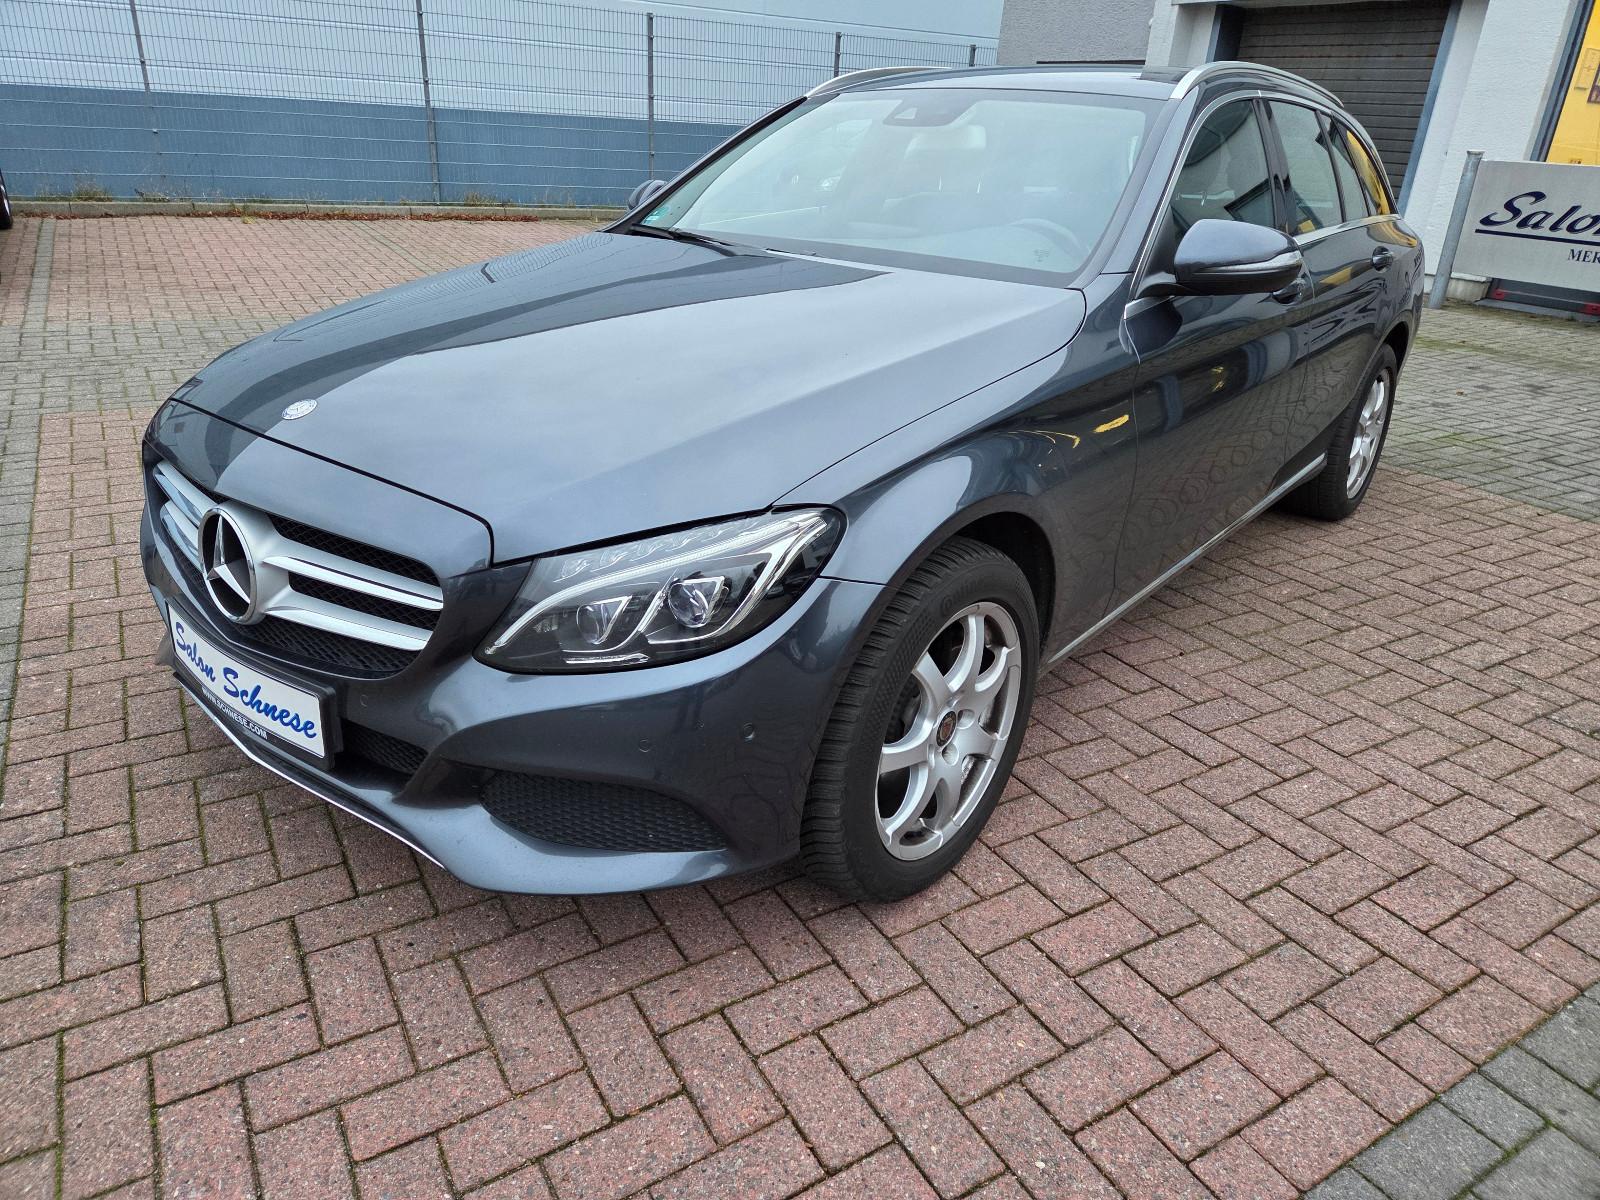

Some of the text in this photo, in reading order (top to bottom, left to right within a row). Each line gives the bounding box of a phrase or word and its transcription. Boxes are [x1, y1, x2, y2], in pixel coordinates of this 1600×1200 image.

[1479, 190, 1600, 236] Salo
[175, 621, 317, 739] Salon Schnese
